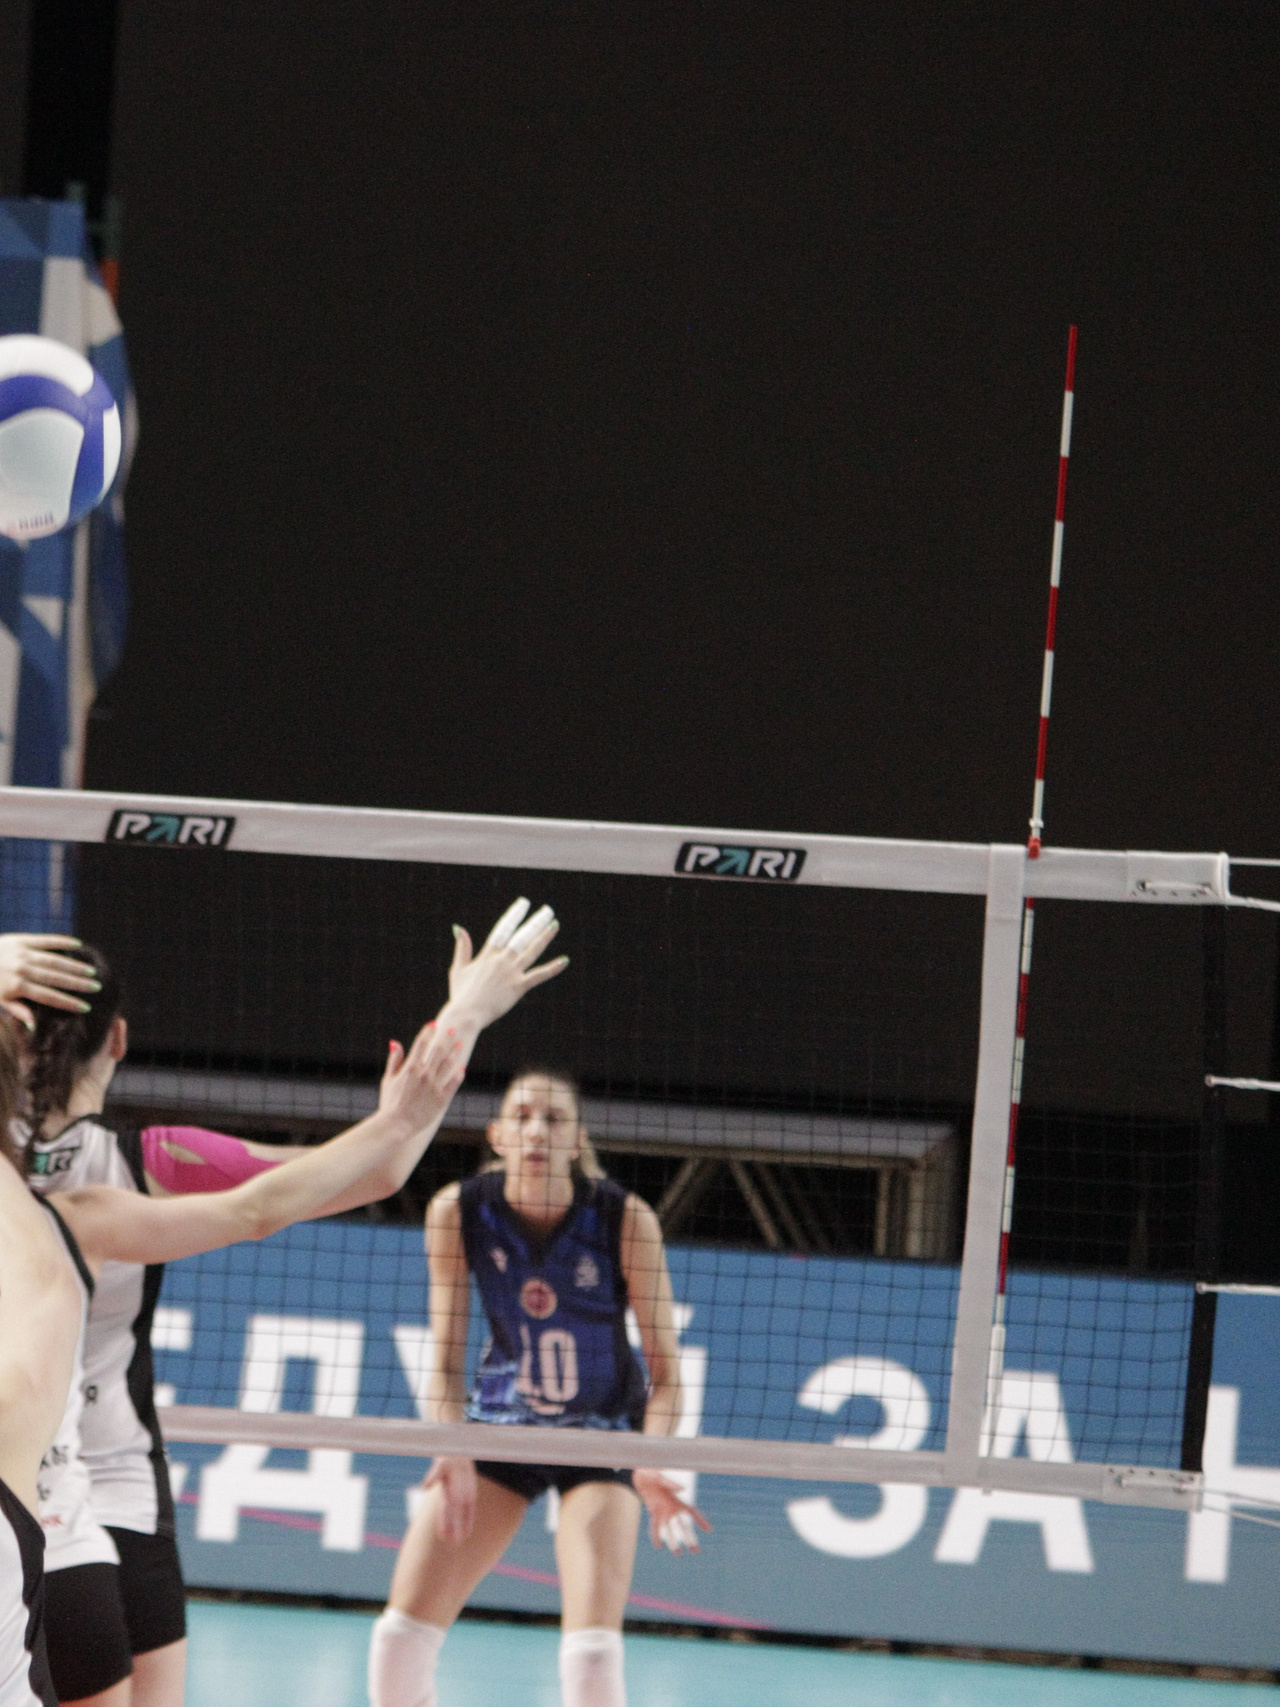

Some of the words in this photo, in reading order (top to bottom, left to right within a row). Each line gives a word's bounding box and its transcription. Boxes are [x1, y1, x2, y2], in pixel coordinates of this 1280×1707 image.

[114, 812, 228, 846] PARI
[683, 844, 798, 879] PARI
[515, 1325, 580, 1403] 10
[785, 1354, 1096, 1574] ЗА
